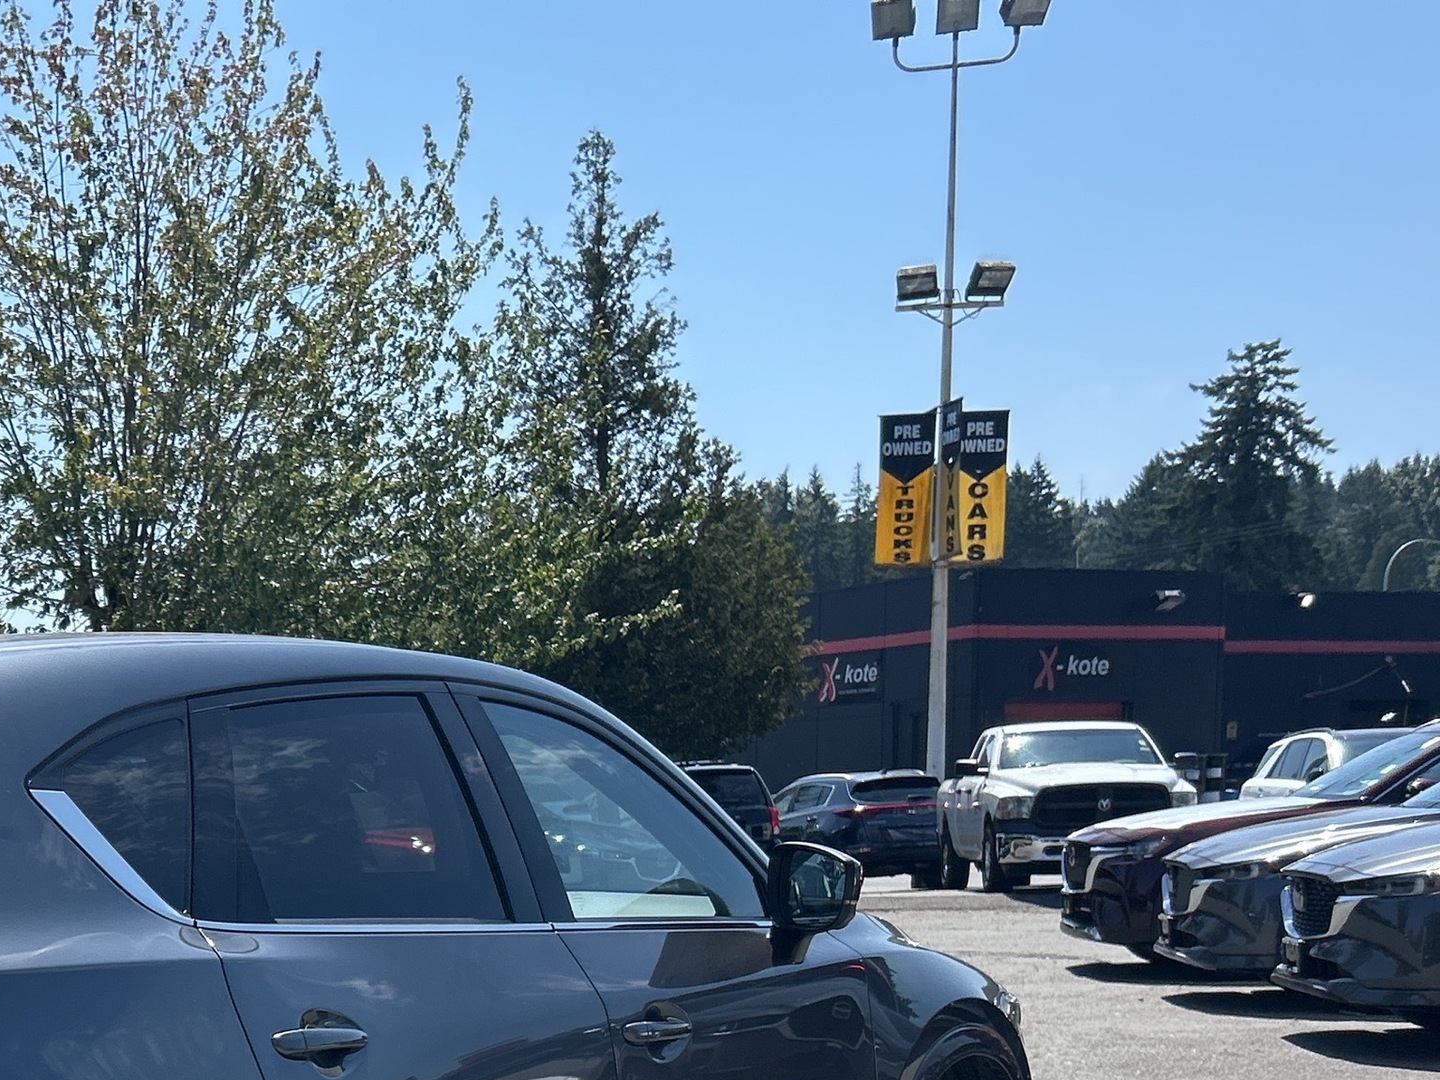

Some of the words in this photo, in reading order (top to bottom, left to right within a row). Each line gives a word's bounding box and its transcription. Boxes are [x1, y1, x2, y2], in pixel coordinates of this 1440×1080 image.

[893, 424, 921, 439] PRE
[966, 421, 994, 437] PRE
[882, 440, 932, 456] OWNED
[967, 482, 989, 561] CARS
